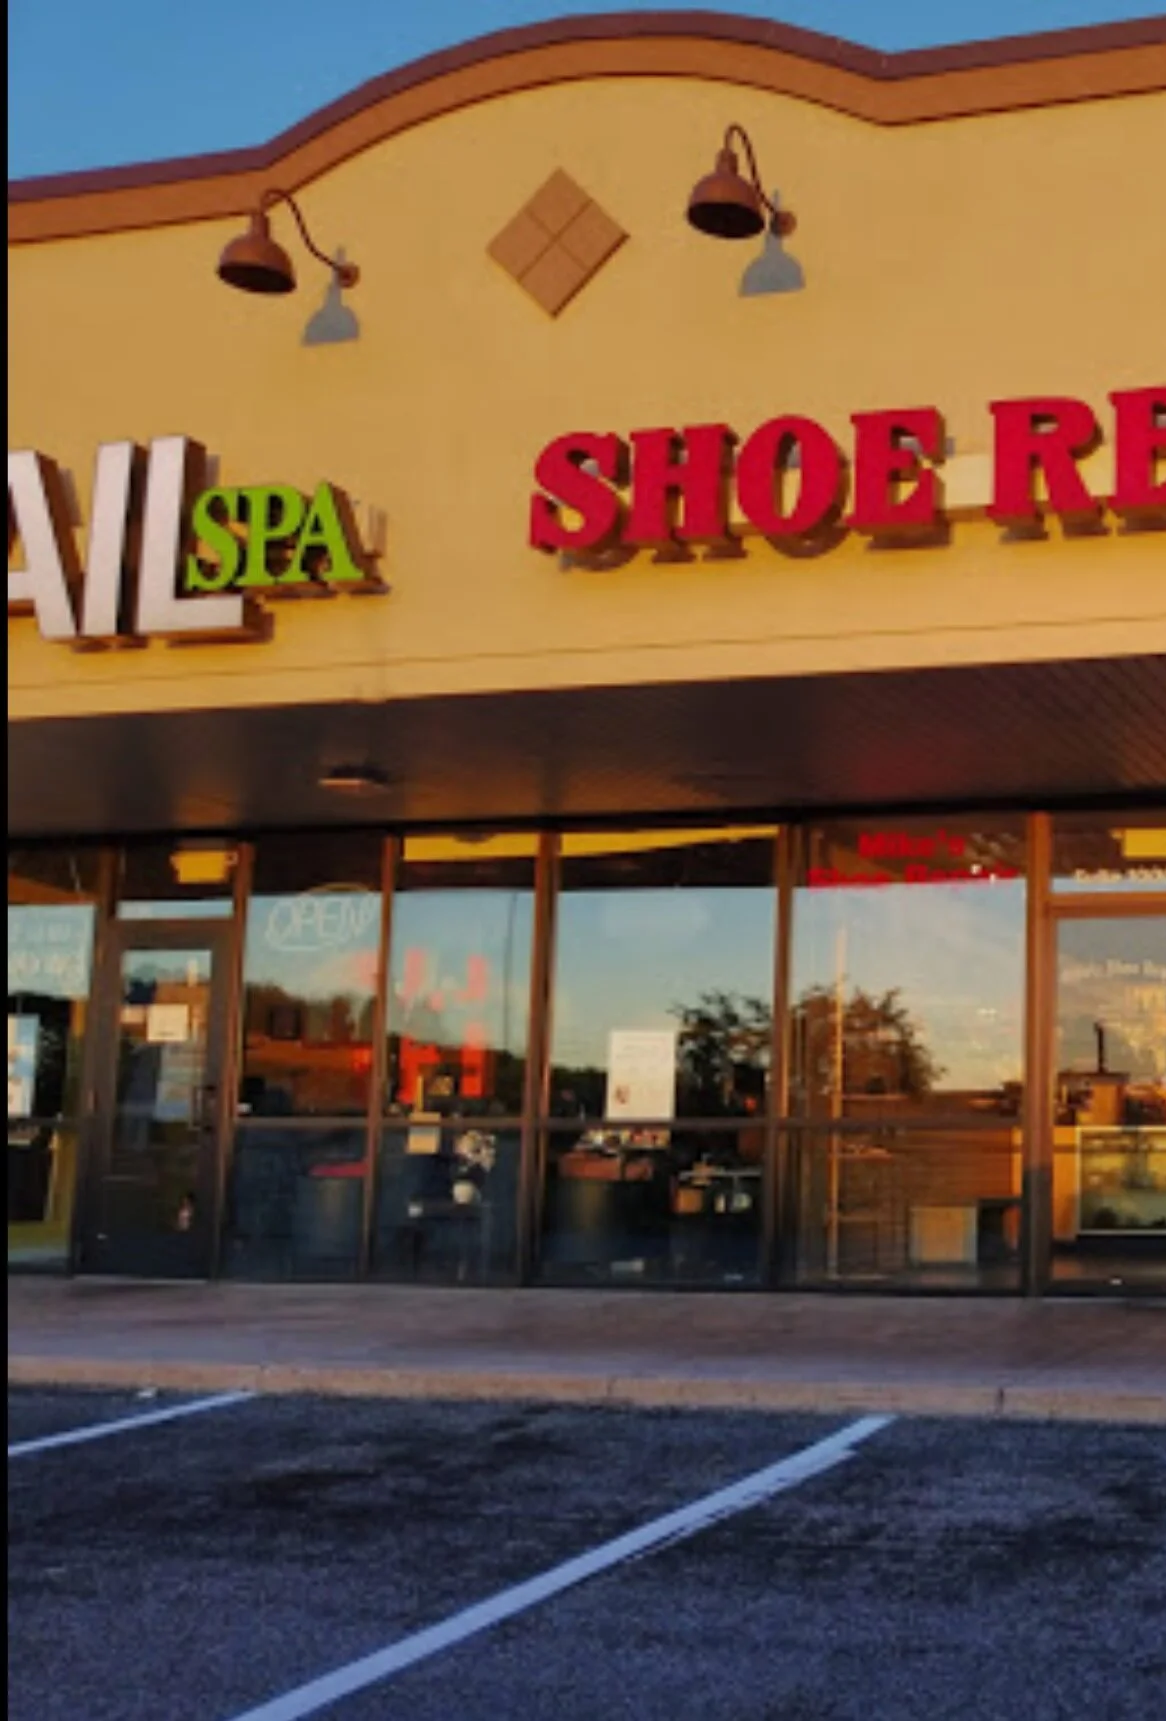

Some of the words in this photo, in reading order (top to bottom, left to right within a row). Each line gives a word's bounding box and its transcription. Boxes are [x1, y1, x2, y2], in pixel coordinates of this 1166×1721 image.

[186, 479, 365, 592] SPA
[529, 408, 940, 552] SHOE
[268, 893, 378, 944] OPEN
